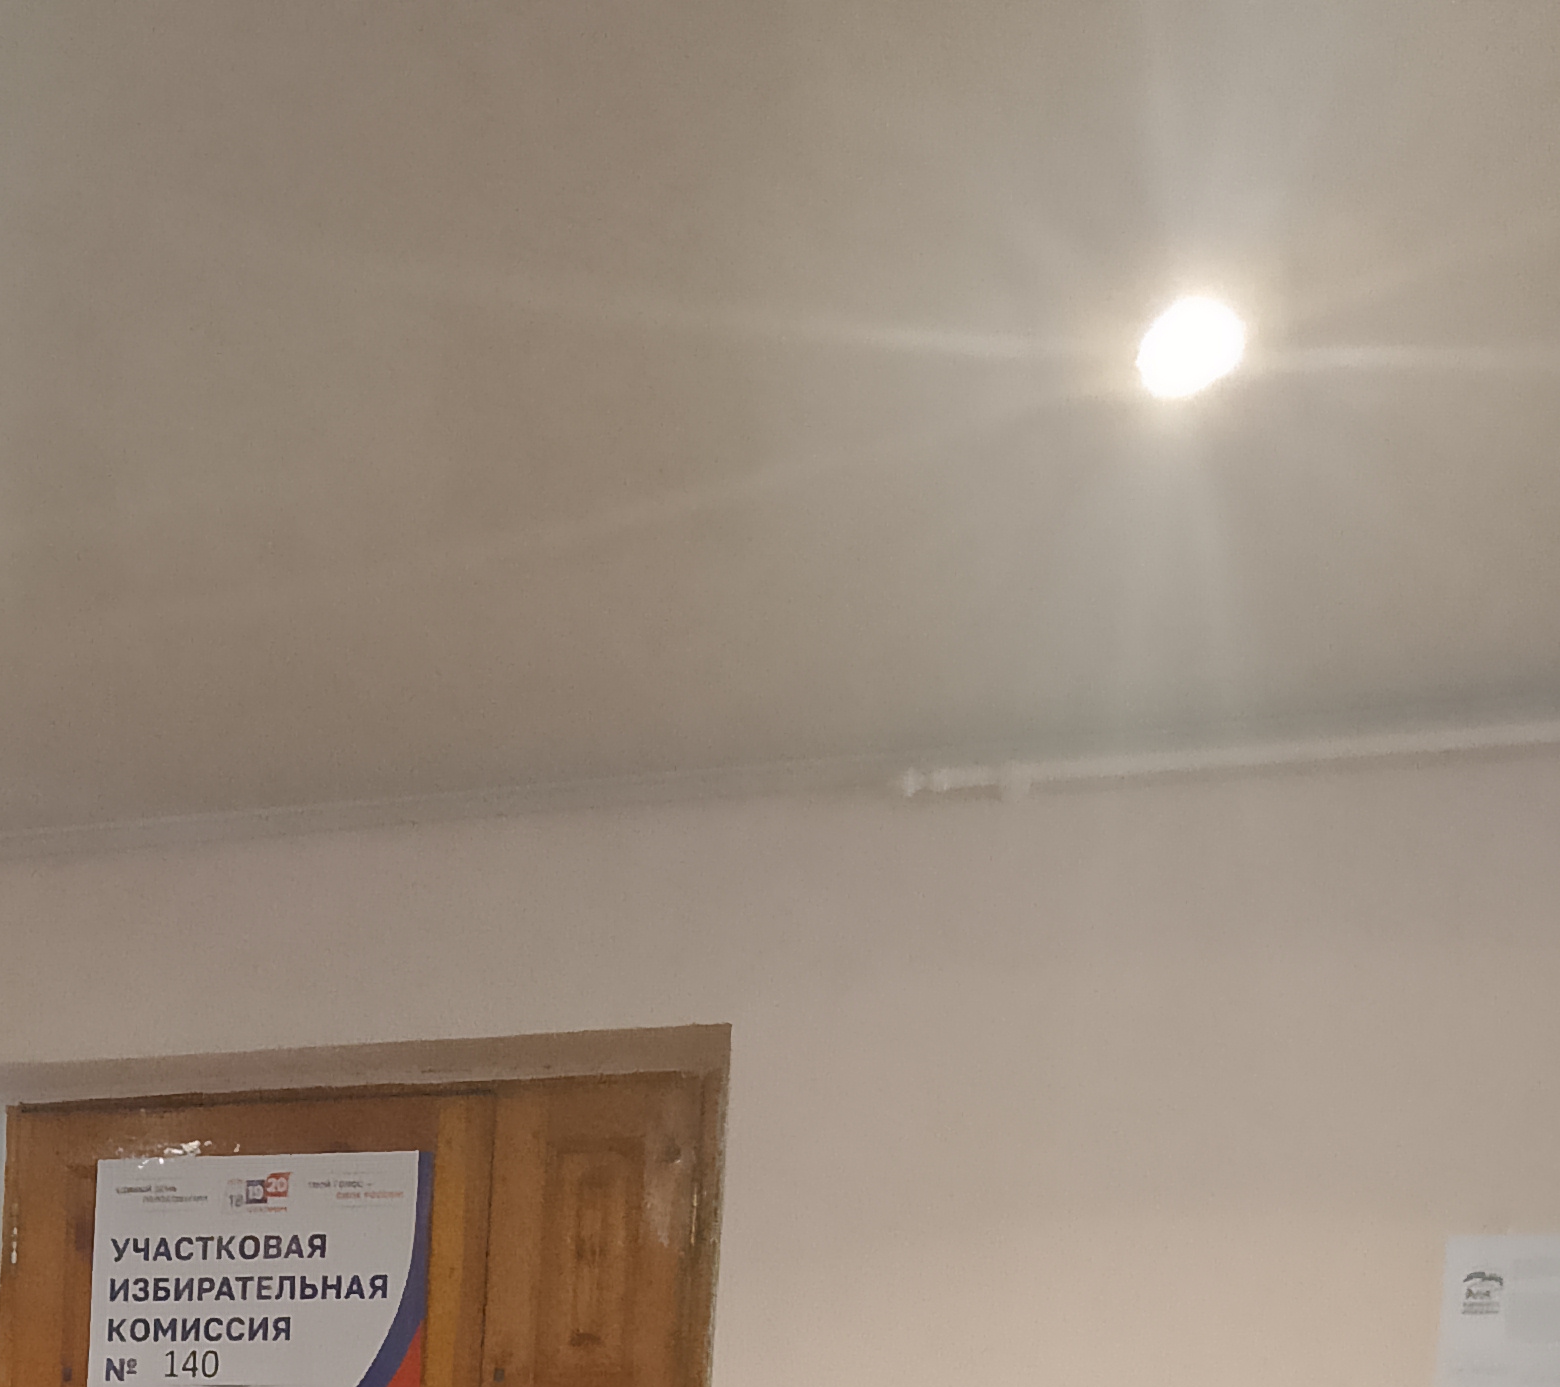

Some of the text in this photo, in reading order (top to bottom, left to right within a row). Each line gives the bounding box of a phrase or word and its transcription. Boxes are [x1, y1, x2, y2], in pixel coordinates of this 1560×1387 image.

[266, 1177, 287, 1193] 20
[110, 1233, 328, 1263] УЧАСТКОВАЯ
[109, 1274, 389, 1302] ИЗБИРАТЕЛЬНАЯ
[106, 1316, 292, 1343] КОМИССИЯ
[105, 1350, 220, 1382] № 140
